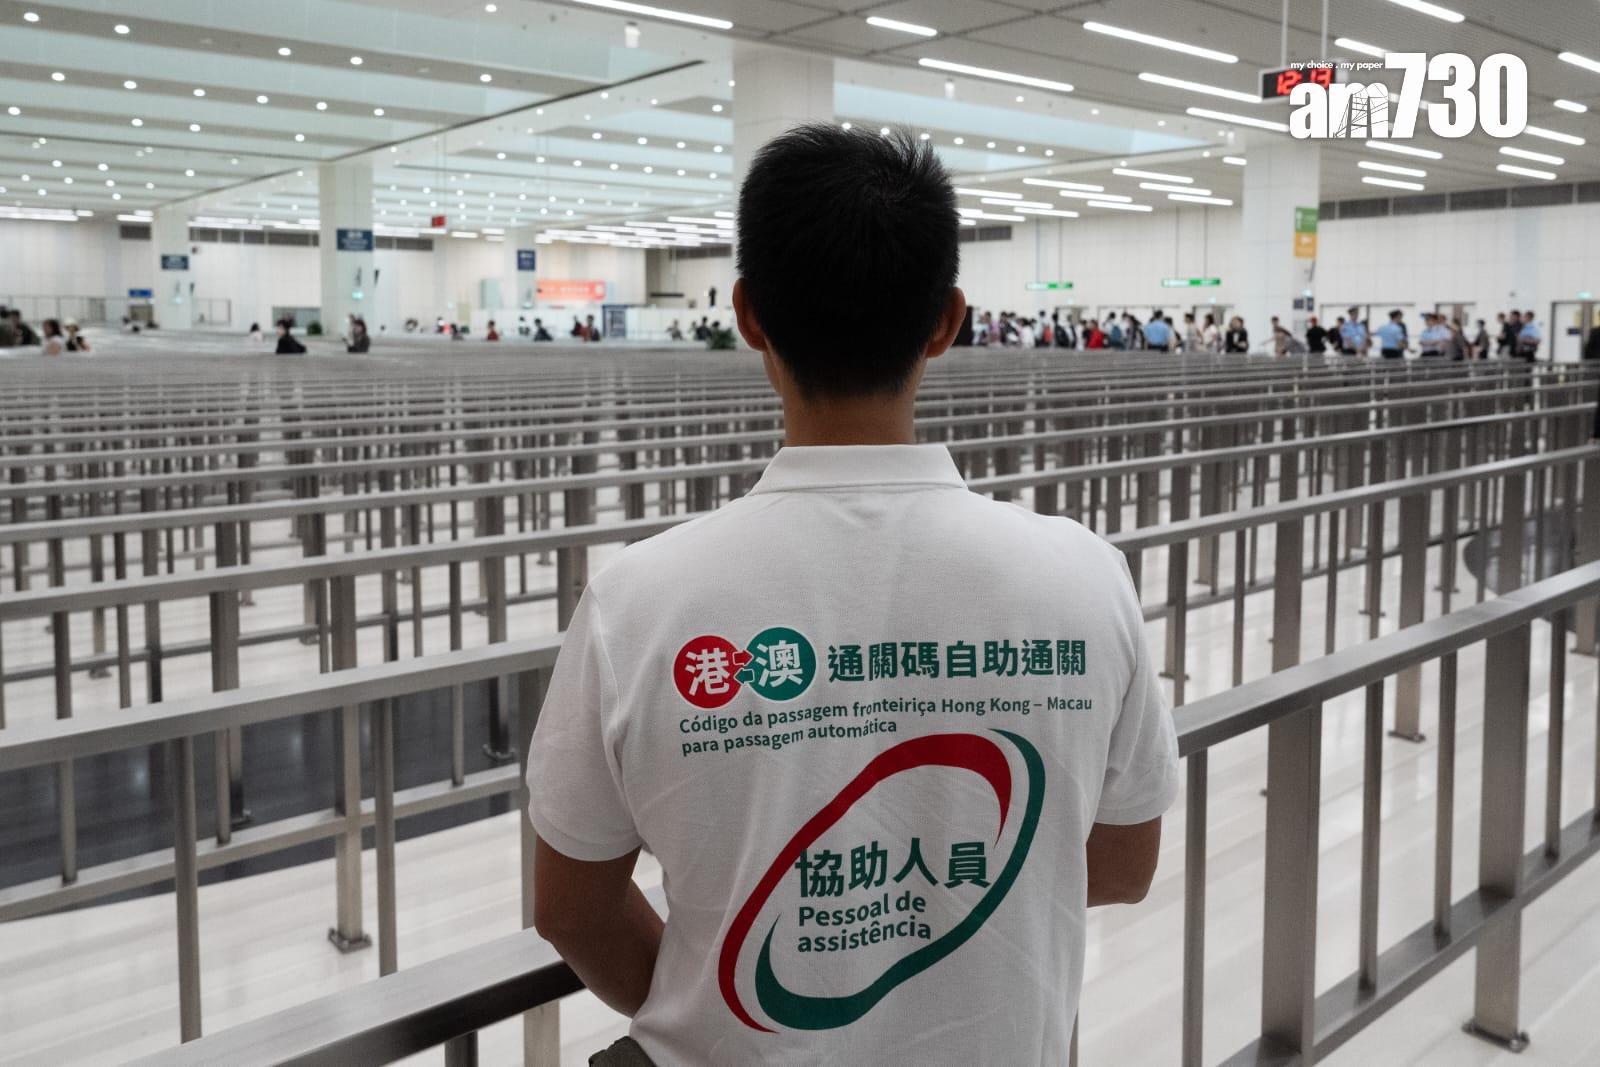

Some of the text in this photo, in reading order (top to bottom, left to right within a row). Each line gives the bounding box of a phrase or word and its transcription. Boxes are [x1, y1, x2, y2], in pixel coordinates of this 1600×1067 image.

[685, 639, 1086, 696] 港 澳 通關碼自助通關
[679, 714, 738, 734] Código
[743, 711, 762, 729] da
[768, 704, 848, 728] passagem
[852, 697, 936, 717] fronteiriça
[942, 698, 986, 716] Hong
[990, 697, 1031, 715] Kong
[1047, 696, 1092, 711] Macau
[682, 718, 897, 757] para passagem automática
[795, 837, 991, 898] 協助人員
[799, 890, 926, 927] Pessoal de
[797, 915, 932, 953] assistência
